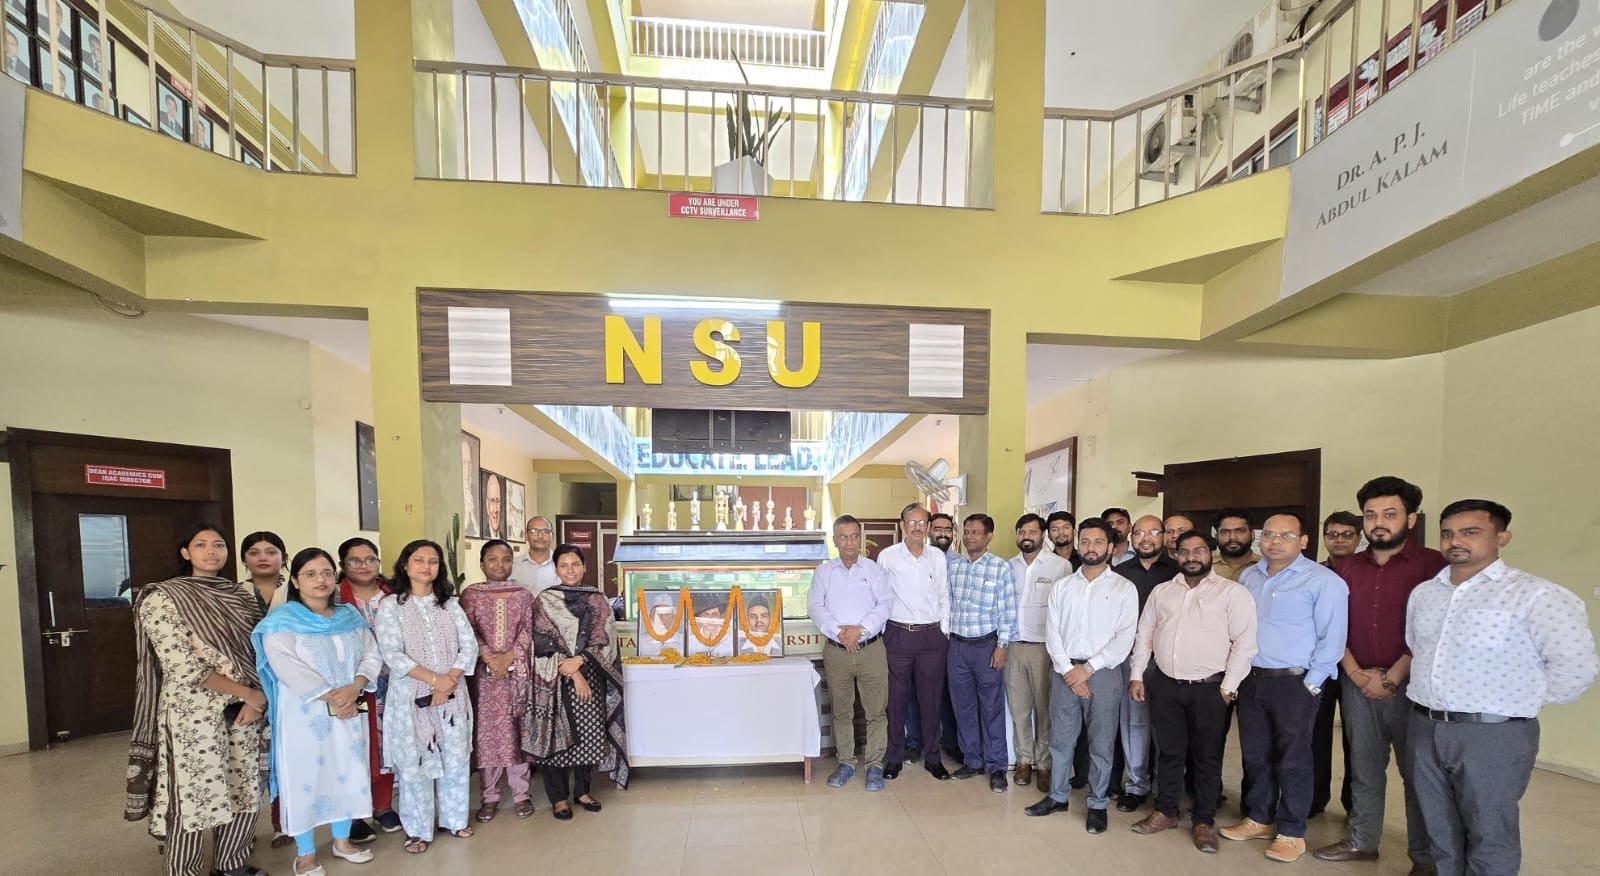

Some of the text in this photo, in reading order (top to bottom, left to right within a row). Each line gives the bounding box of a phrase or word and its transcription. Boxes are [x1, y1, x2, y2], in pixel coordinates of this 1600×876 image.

[1524, 34, 1586, 81] are the
[1498, 92, 1527, 118] Life
[1521, 91, 1560, 125] TIME
[1336, 120, 1425, 191] DR. A. P. J.
[1315, 138, 1448, 231] ABDUL KALAM
[681, 206, 747, 217] CCTV SURVEILLANCE
[688, 197, 739, 207] YOU ARE UNDER
[108, 469, 146, 478] ACADEMICS
[120, 476, 152, 484] DIRECTOR
